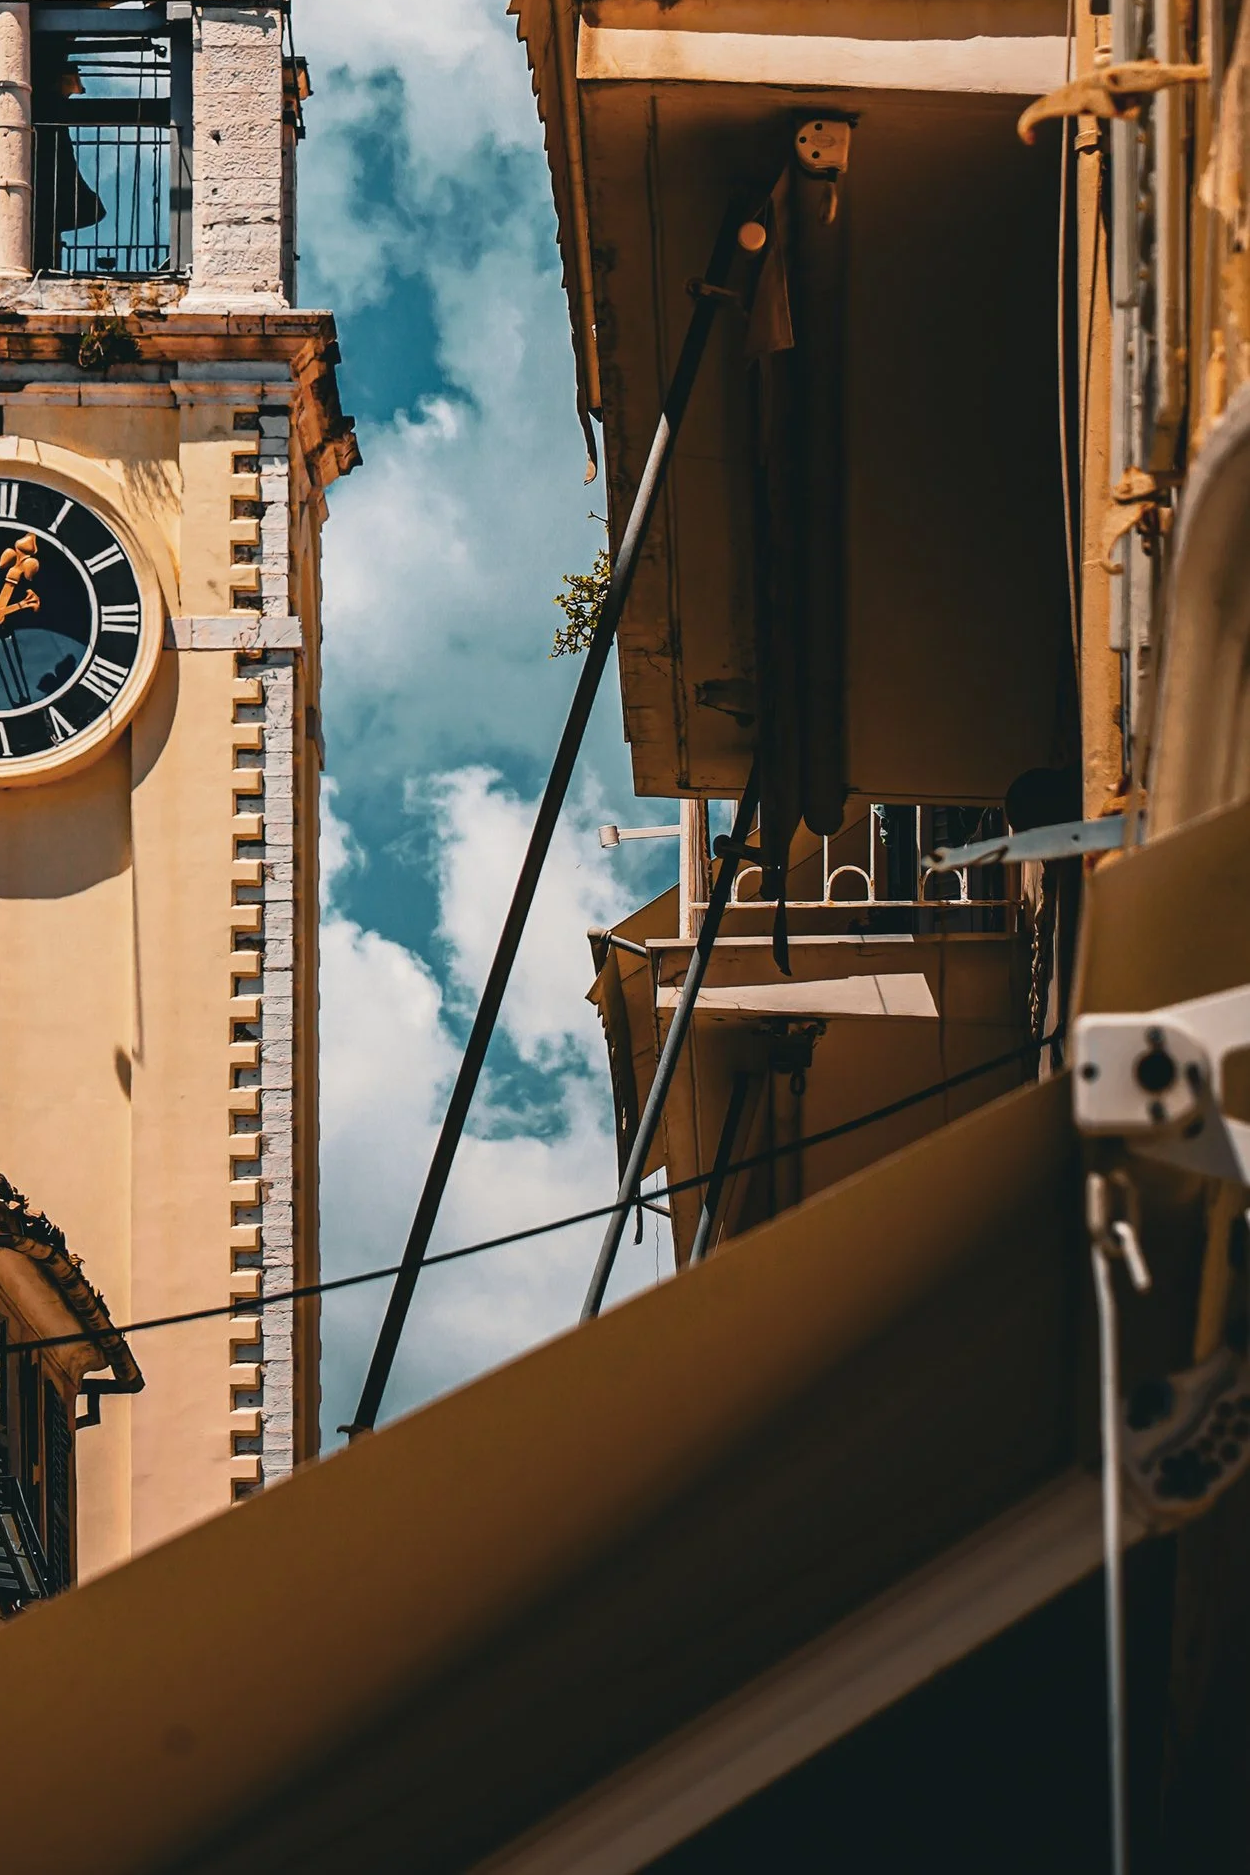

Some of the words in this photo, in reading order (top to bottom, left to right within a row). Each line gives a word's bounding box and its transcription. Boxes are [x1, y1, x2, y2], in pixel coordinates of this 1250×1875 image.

[47, 499, 74, 533] I
[84, 543, 125, 575] II
[101, 602, 139, 635] III
[78, 654, 129, 703] IIII
[49, 706, 77, 742] V
